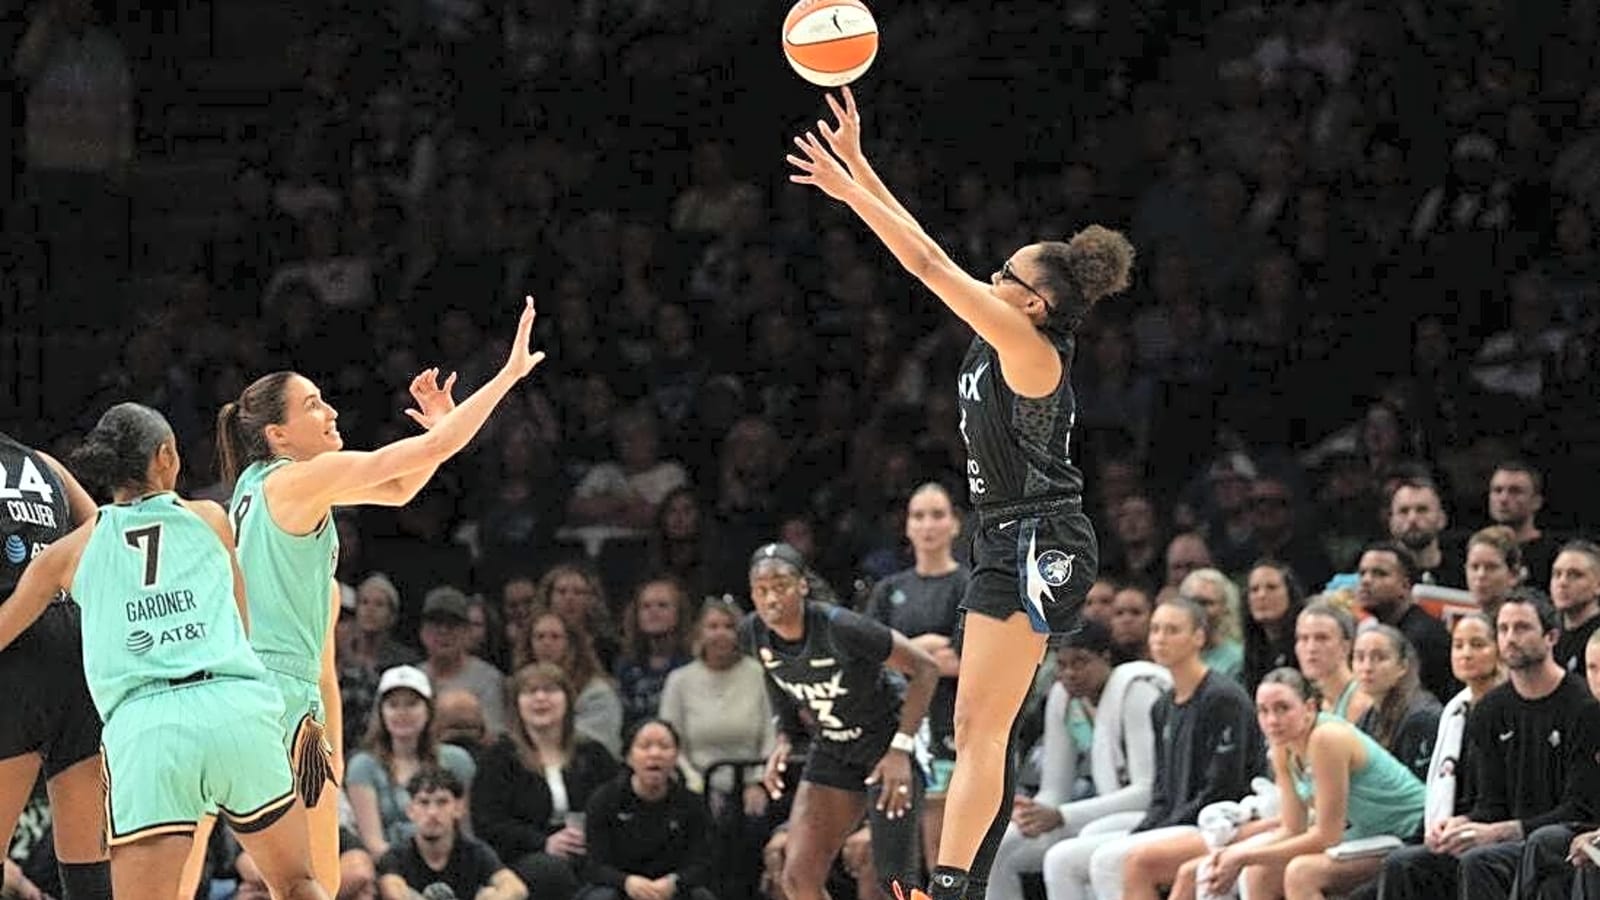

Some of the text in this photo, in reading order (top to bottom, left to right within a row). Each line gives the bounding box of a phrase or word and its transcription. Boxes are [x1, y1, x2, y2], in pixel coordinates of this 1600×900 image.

[7, 500, 57, 529] COLLIER
[123, 522, 162, 588] 7
[126, 589, 197, 622] GARDNER
[160, 622, 207, 645] AT&T
